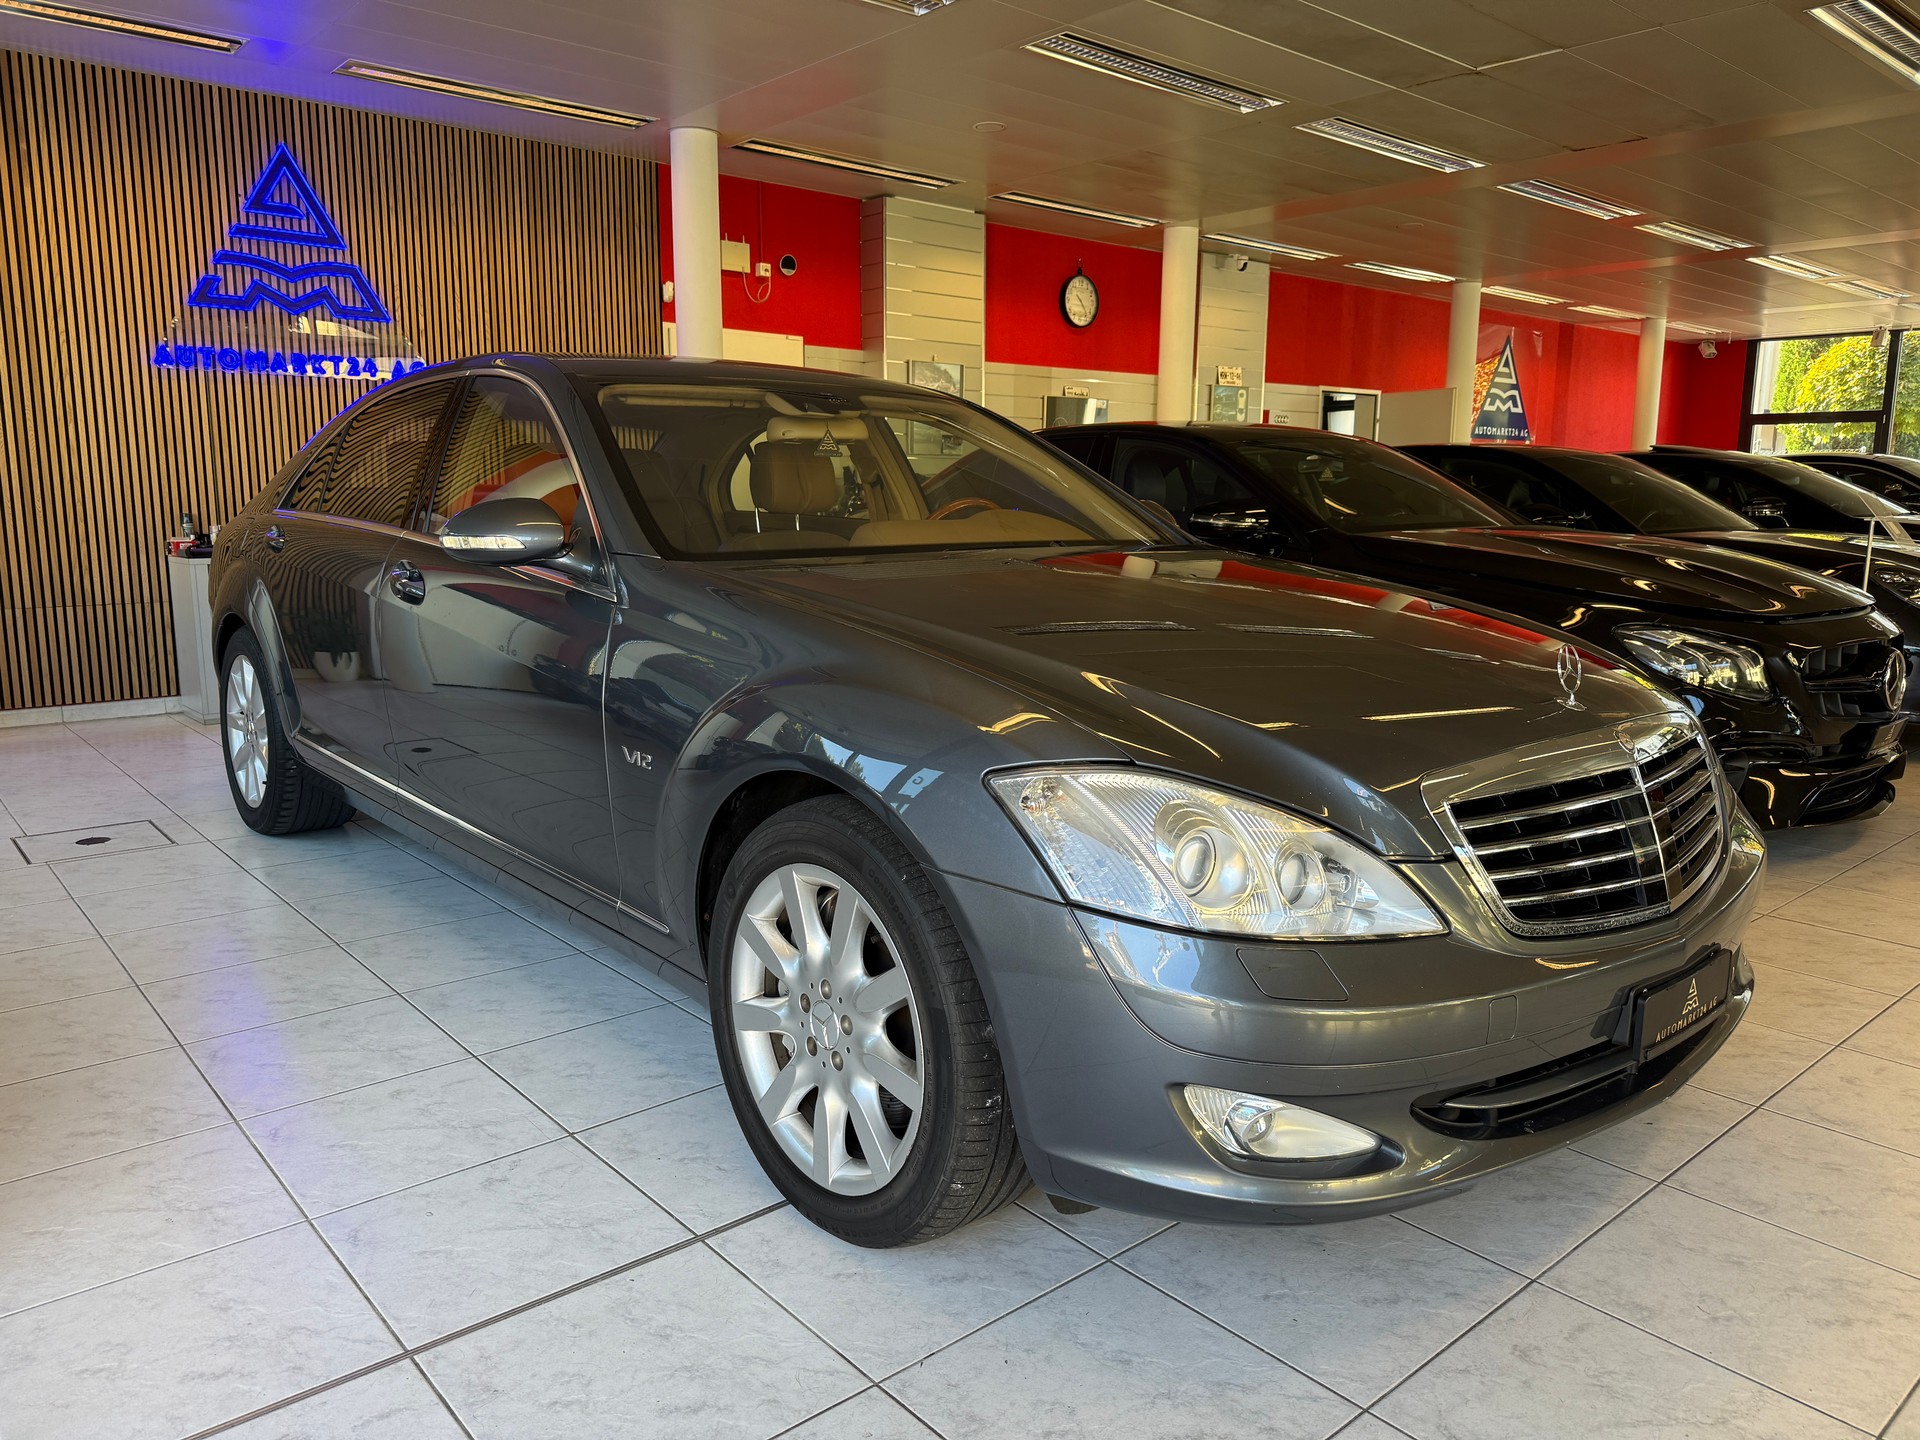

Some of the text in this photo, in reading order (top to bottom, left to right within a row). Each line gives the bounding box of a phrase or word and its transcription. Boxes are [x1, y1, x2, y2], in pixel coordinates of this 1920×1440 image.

[154, 344, 378, 377] AUTOMARKT24
[1474, 426, 1528, 437] AUTOMARKT24 AG
[621, 745, 652, 770] V12
[1655, 996, 1718, 1043] AUTOMARKT24 AG
